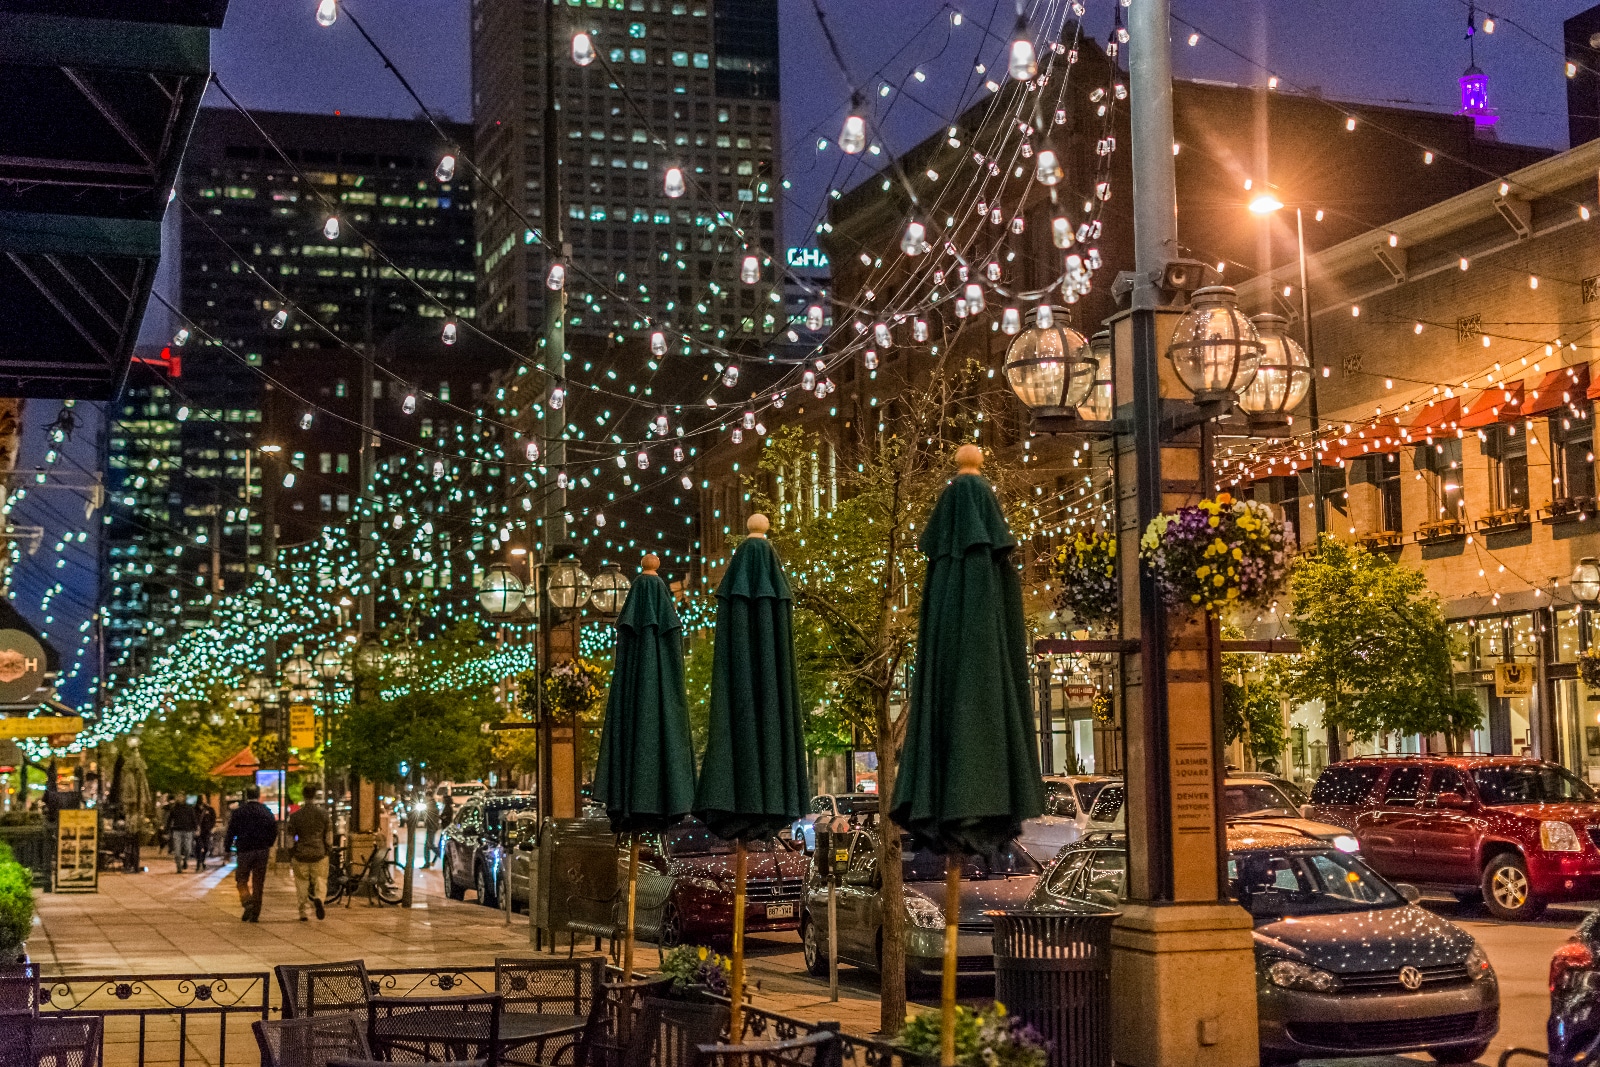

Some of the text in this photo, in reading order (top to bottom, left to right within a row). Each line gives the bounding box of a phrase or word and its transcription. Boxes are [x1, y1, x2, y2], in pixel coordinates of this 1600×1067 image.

[1175, 758, 1208, 766] LARIMER
[1176, 769, 1209, 777] SQUARE
[1176, 792, 1210, 800] DENVER
[1177, 803, 1210, 811] HISTORIC
